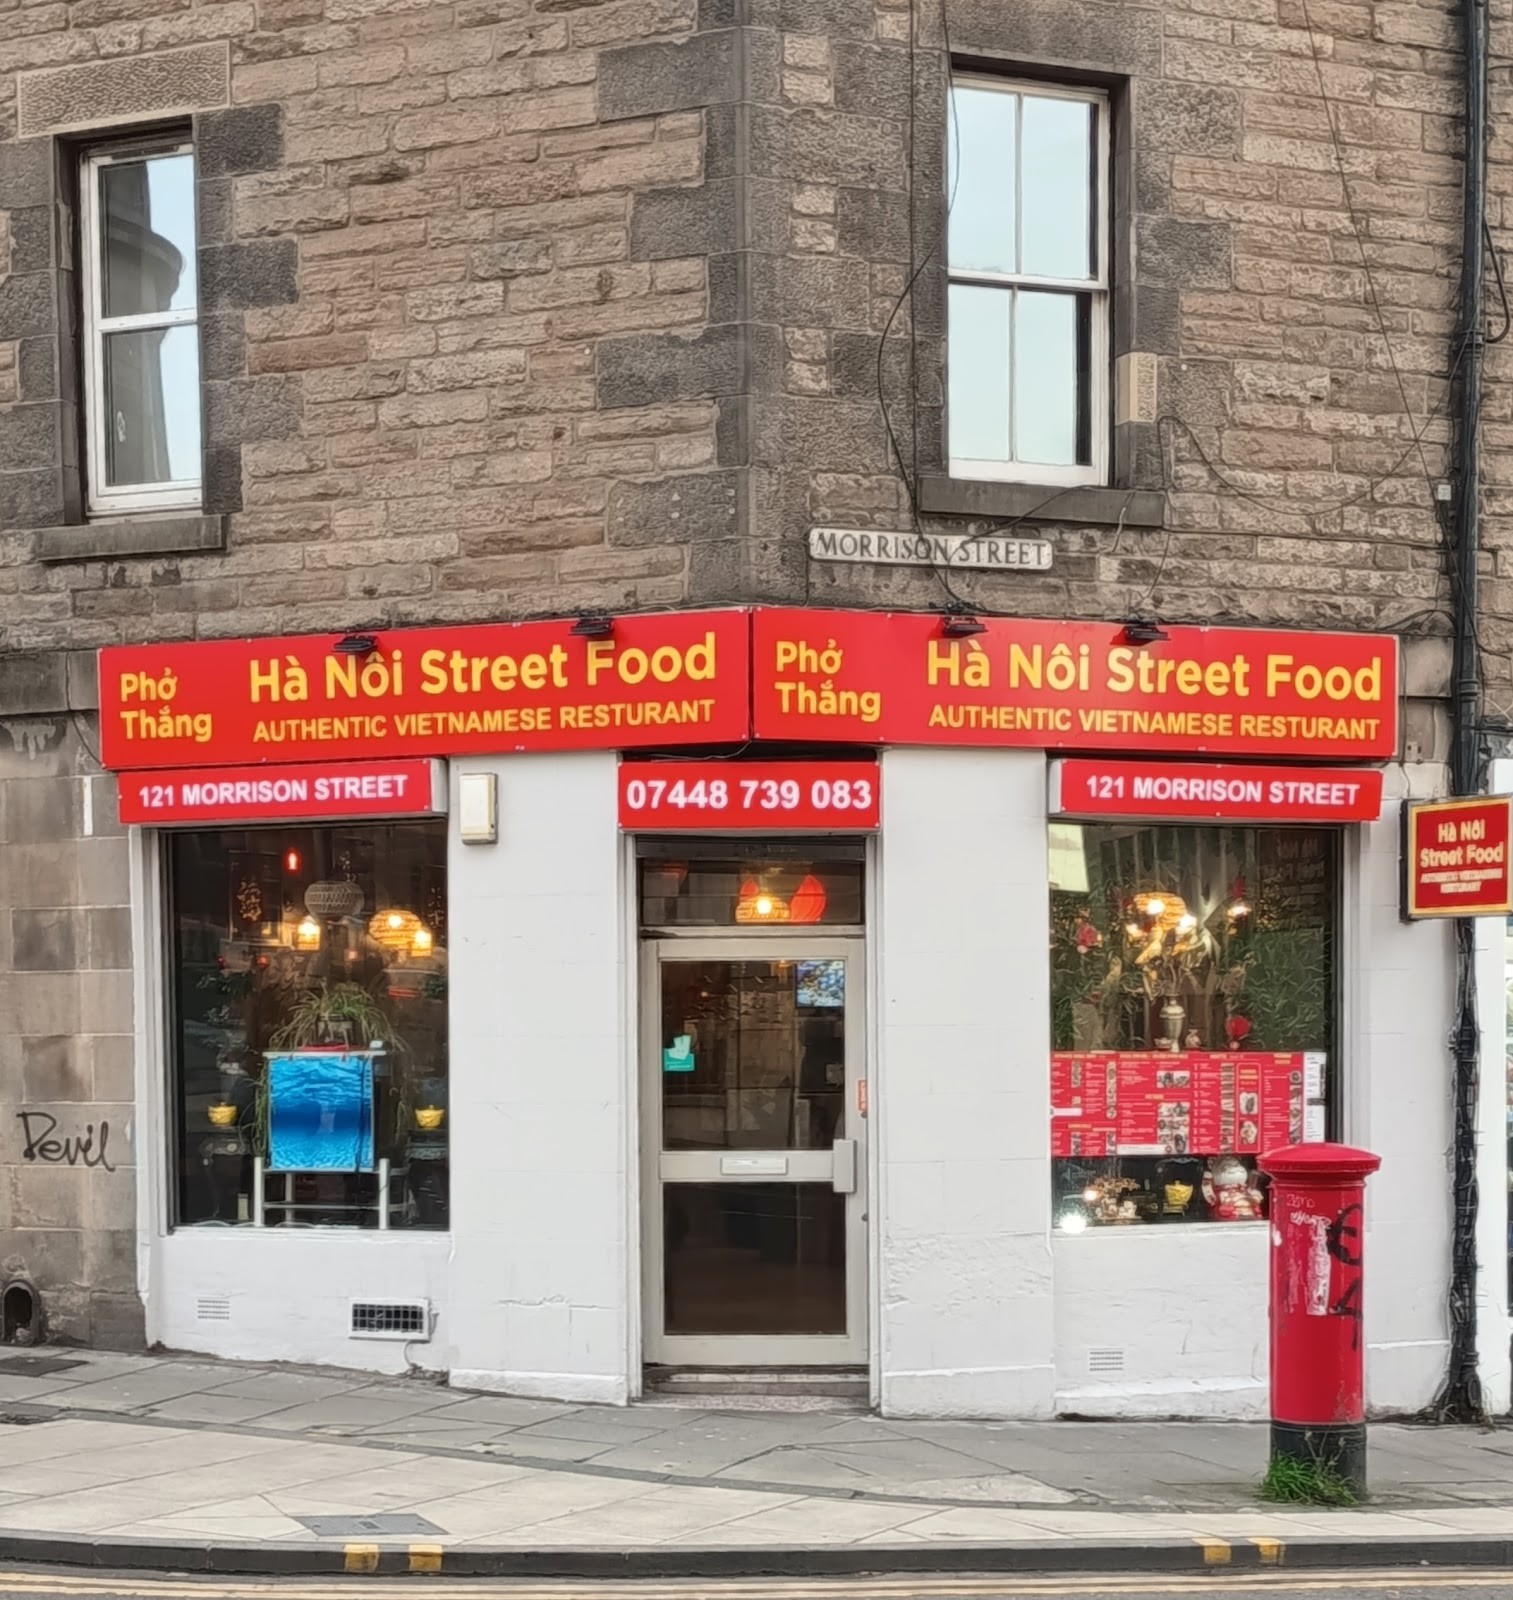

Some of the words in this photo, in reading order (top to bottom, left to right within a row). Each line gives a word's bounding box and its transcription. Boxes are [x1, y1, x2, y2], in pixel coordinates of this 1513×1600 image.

[817, 531, 949, 562] MORRISON
[958, 539, 1047, 566] STREET
[250, 655, 308, 703] Hà
[420, 644, 568, 694] Street
[587, 631, 716, 686] Food
[927, 638, 990, 688] Hà
[1106, 646, 1250, 697] Street
[1266, 654, 1381, 701] Food
[253, 715, 387, 742] AUTHENTIC
[394, 707, 552, 736] VIETNAMESE
[559, 699, 715, 728] RESTURANT
[928, 704, 1072, 731] AUTHENTIC
[1077, 708, 1233, 736] VIETNAMESE
[1240, 714, 1380, 740] RESTURANT
[139, 785, 174, 807] 121
[182, 779, 308, 806] MORRISON
[314, 774, 408, 801] STREET
[626, 779, 729, 810] 07448
[739, 779, 800, 809] 739
[811, 779, 872, 810] 083
[1086, 775, 1124, 798] 121
[1133, 776, 1263, 803] MORRISON
[1269, 781, 1360, 805] STREET
[1420, 846, 1463, 868] Street
[1466, 843, 1504, 864] Food
